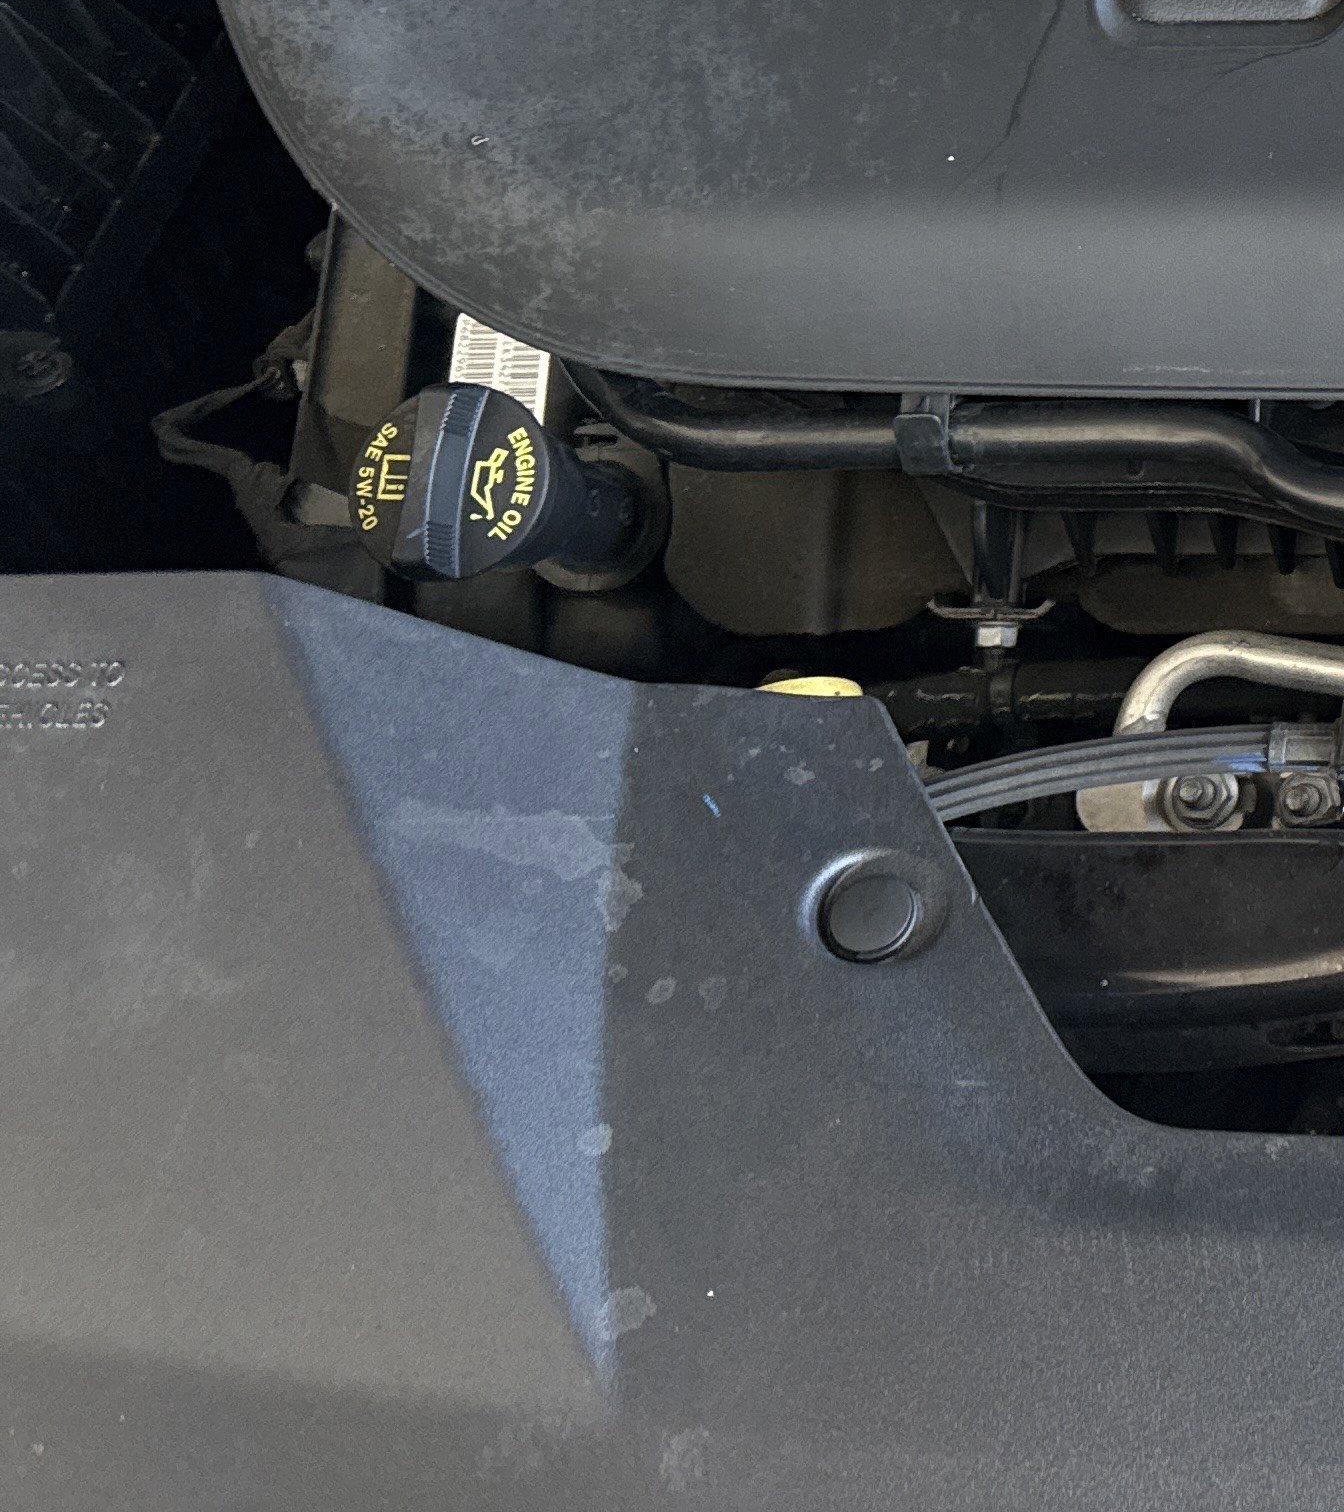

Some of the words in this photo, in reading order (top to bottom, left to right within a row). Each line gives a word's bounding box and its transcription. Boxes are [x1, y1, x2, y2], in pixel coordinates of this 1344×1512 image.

[364, 422, 398, 462] SAE
[507, 427, 536, 507] ENGINE
[355, 466, 379, 531] 5W-20
[487, 509, 522, 541] OIL
